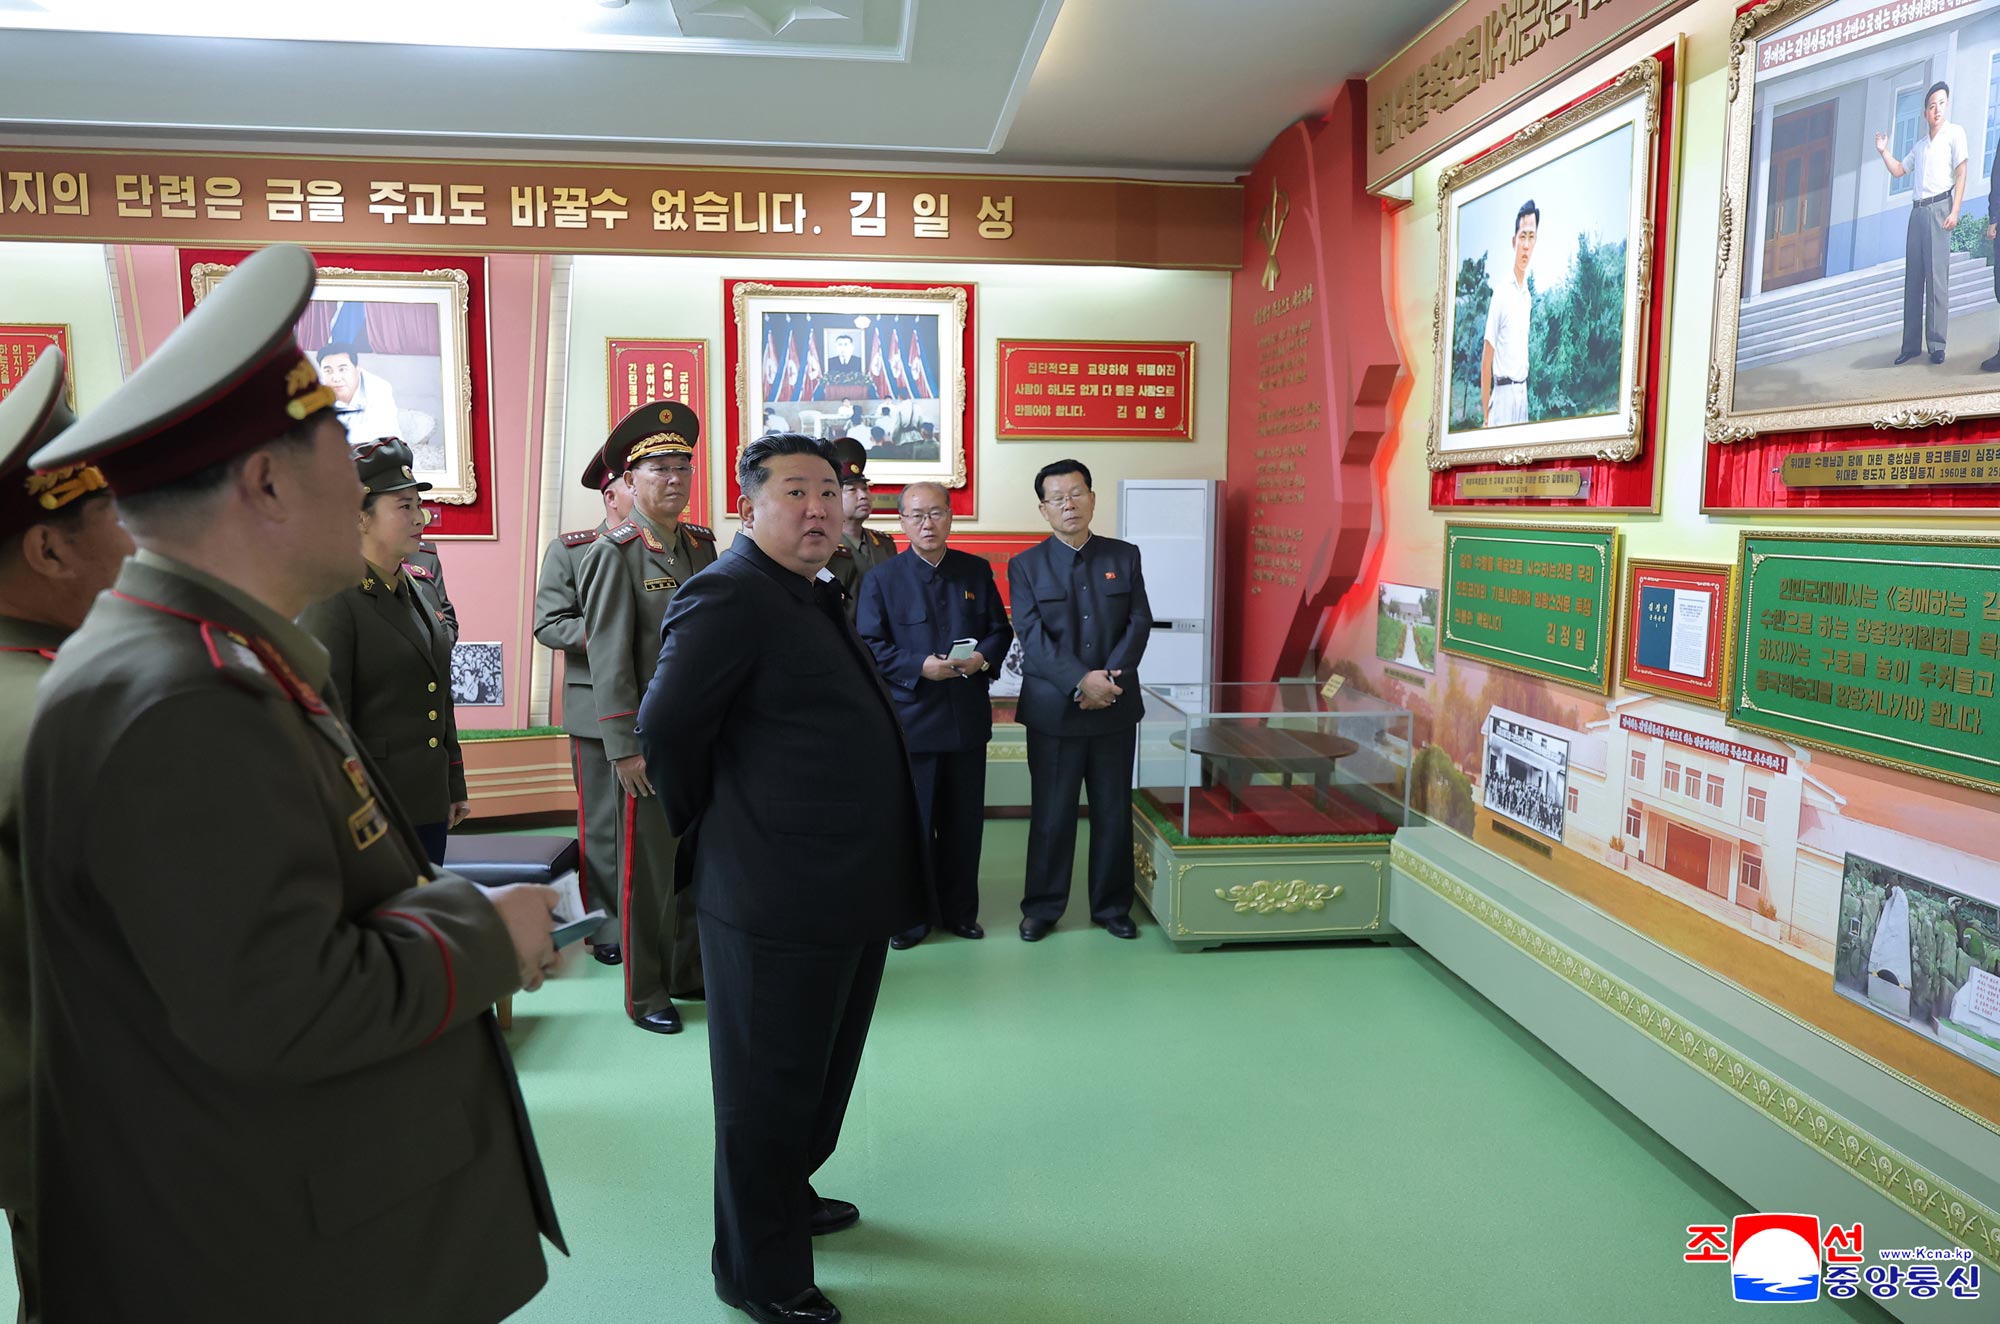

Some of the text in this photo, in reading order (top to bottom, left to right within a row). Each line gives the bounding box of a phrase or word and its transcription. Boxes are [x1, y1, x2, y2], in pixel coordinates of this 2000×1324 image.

[115, 174, 243, 220] 단련은
[265, 178, 345, 223] 금을
[368, 180, 487, 225] 주고도
[510, 185, 629, 230] 바꿀수
[651, 188, 822, 235] 없습니다.
[848, 191, 887, 237] 김
[912, 193, 950, 239] 일
[976, 195, 1014, 240] 성
[1027, 362, 1176, 376] 집단적으로 교양하여 뒤떨어진
[1015, 384, 1043, 395] 사람이
[1047, 384, 1076, 396] 하나도
[1079, 384, 1099, 396] 없게
[1102, 385, 1112, 396] 다
[1138, 385, 1176, 397] 사람으로
[1014, 405, 1166, 419] 만들어야 합니다. 김 일 성
[1835, 466, 2000, 481] 위대한 령도자 김정일동지 1960년 8월 25
[1867, 453, 1883, 466] 대한
[1887, 452, 1920, 465] 충성심을
[1779, 577, 1878, 609] 인민군대에서는
[1886, 585, 1968, 618] 《경애하는
[1546, 622, 1557, 645] 김
[1560, 624, 1571, 647] 정
[1575, 628, 1586, 652] 일
[1760, 608, 2000, 660] 수반으로 하는 당중앙위원회를 목
[1820, 647, 1867, 677] 구호를
[1876, 655, 1911, 685] 높이
[1918, 661, 1995, 698] 추켜들고
[1928, 700, 1984, 735] 합니다.
